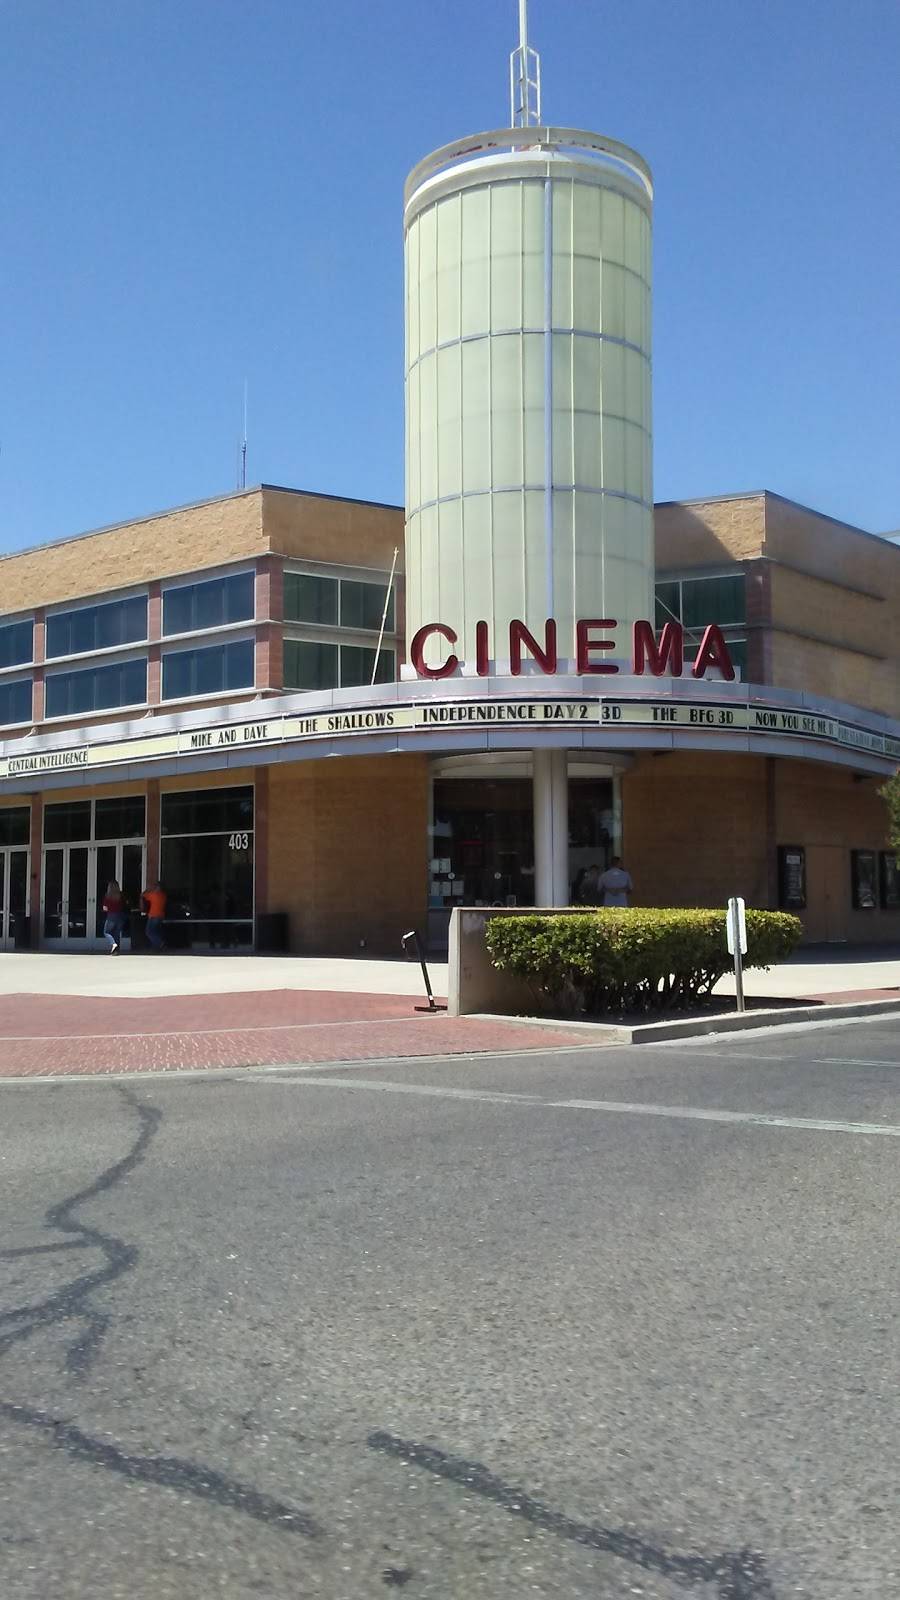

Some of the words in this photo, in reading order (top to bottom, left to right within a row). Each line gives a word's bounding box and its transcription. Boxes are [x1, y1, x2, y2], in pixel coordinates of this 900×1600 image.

[410, 619, 735, 681] CINEMA
[299, 719, 318, 733] THE
[327, 712, 394, 730] SHALLOWS
[423, 705, 536, 722] INDEPENDENCE
[602, 706, 621, 720] 3D
[651, 706, 677, 721] THE
[690, 708, 714, 723] BFG
[718, 710, 734, 724] 3D
[755, 711, 778, 726] NOW
[781, 714, 799, 729] YOU
[802, 717, 816, 732] SEE
[191, 732, 213, 748] MIKE
[218, 730, 237, 744] AND
[244, 724, 268, 741] DAVE
[8, 758, 38, 772] CENTRAL
[39, 750, 88, 769] INTELLIGENCE
[228, 833, 249, 850] 403
